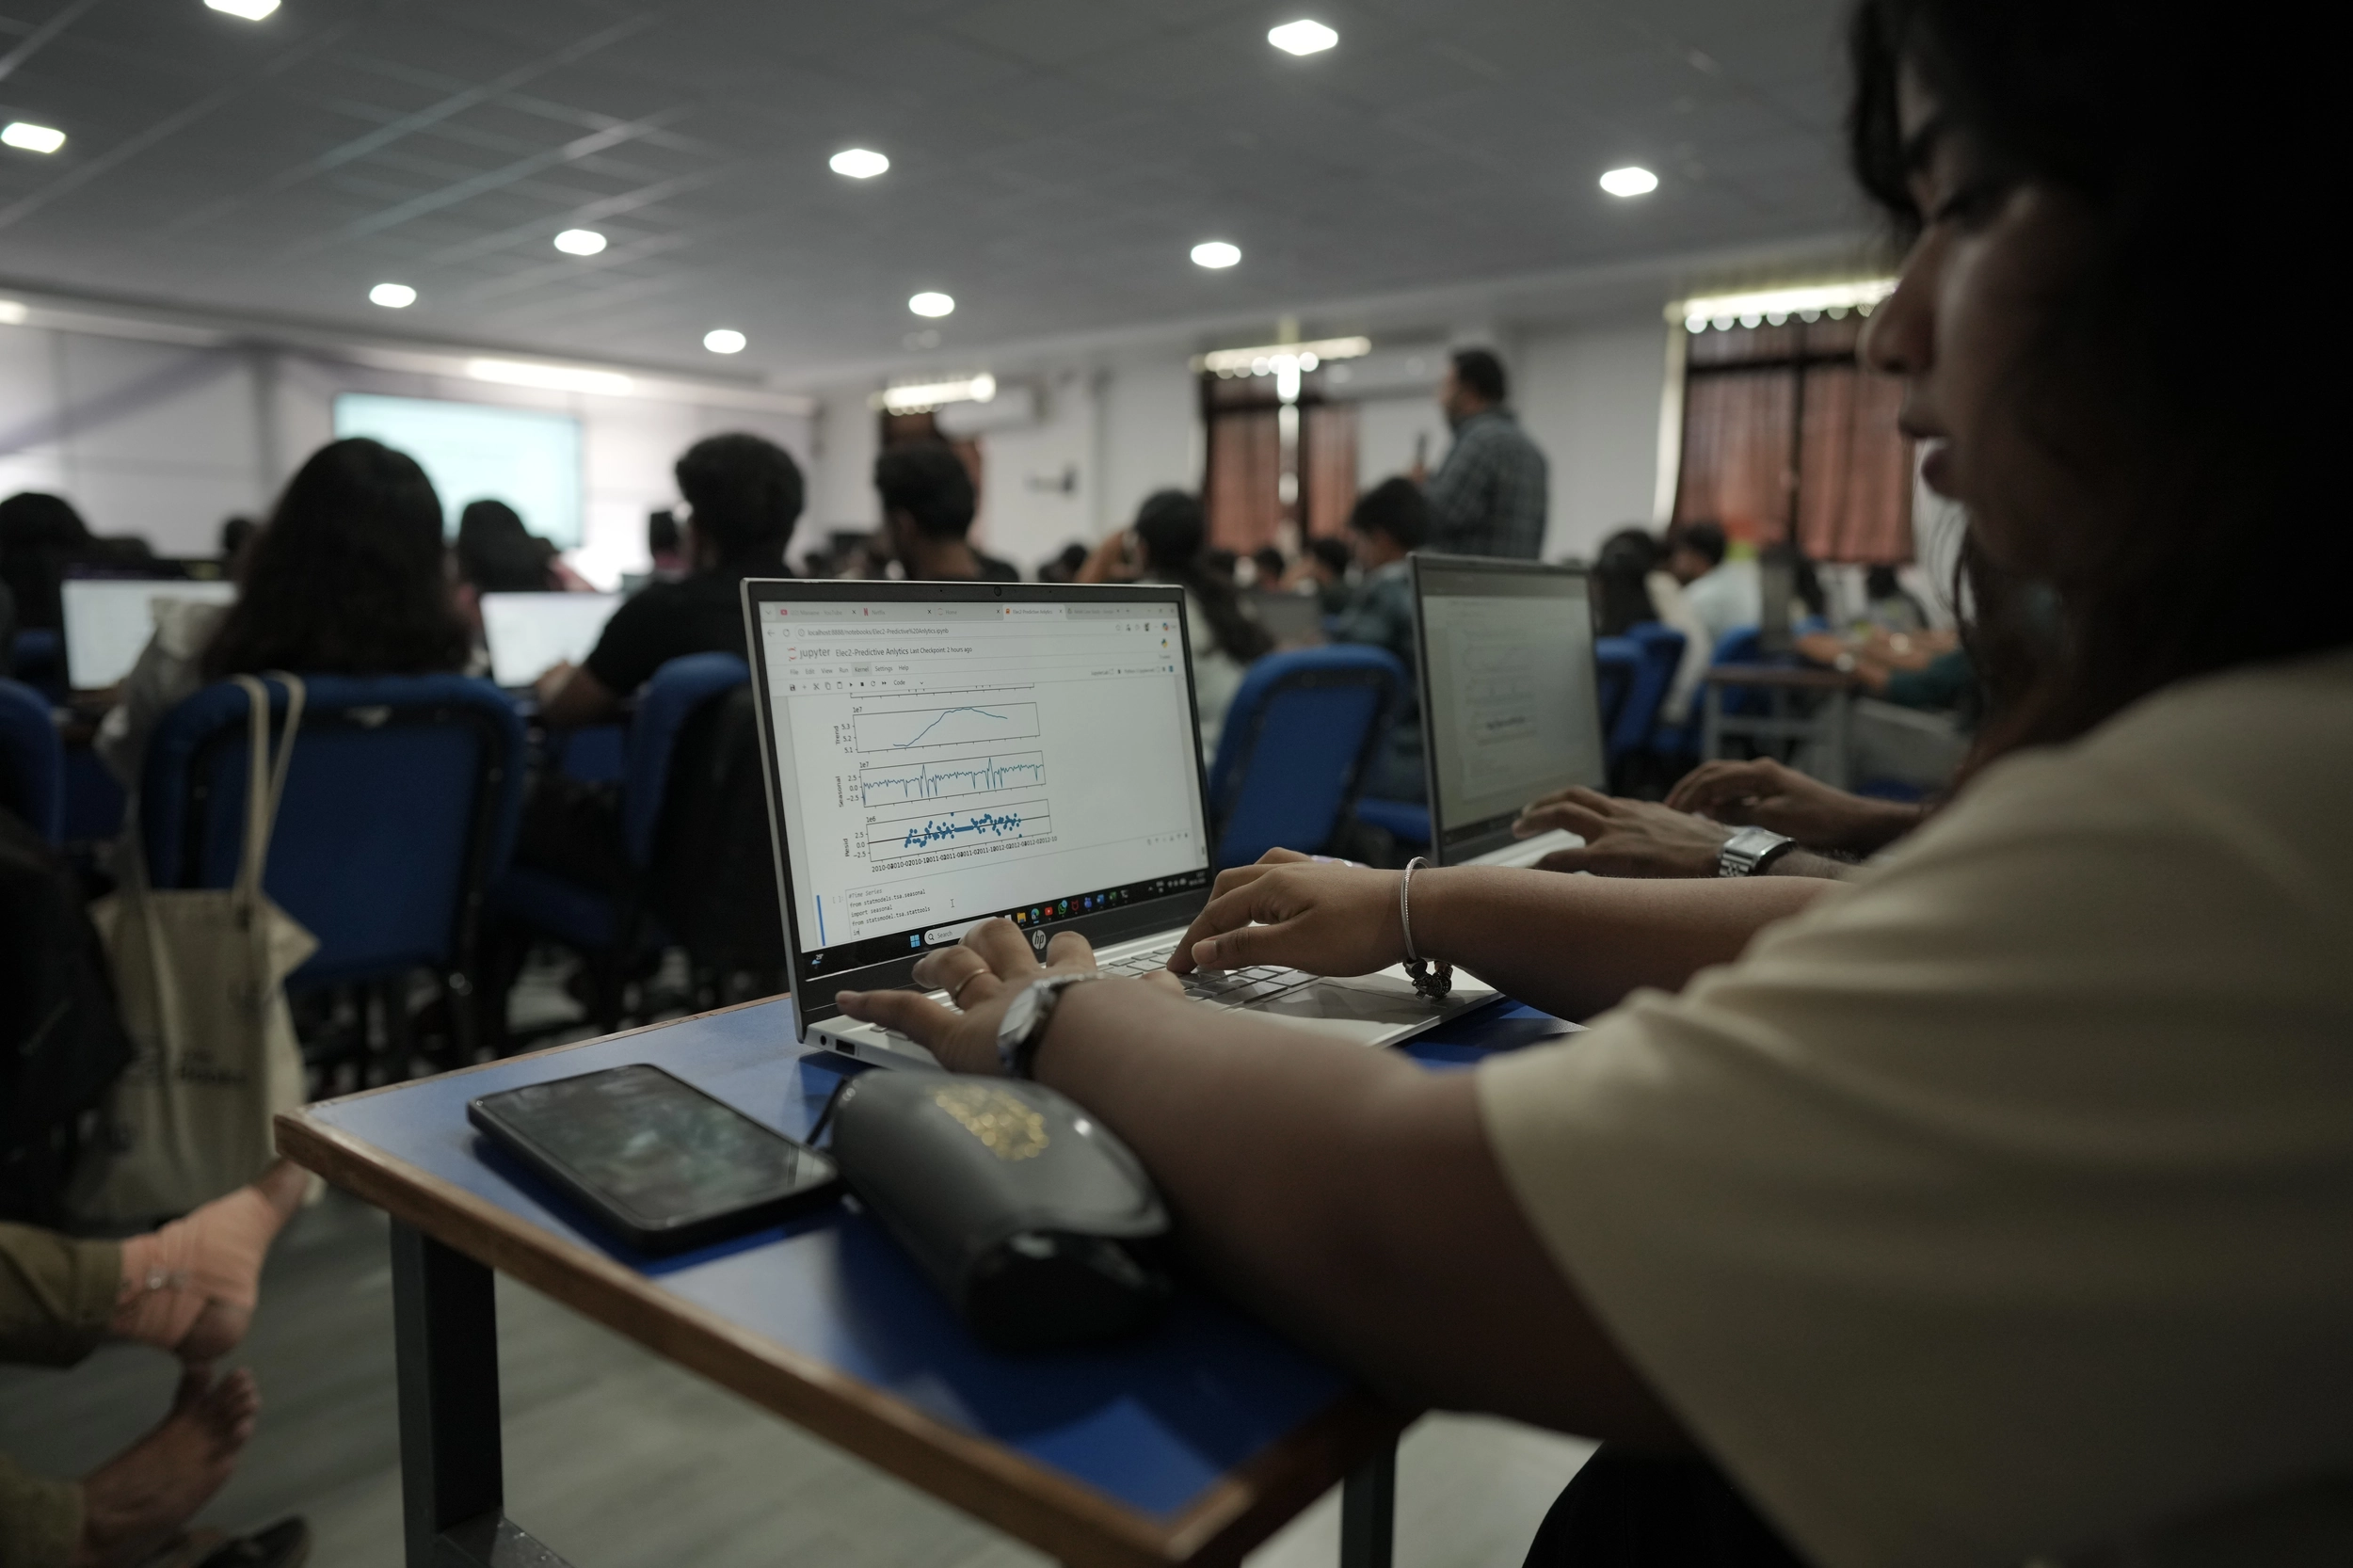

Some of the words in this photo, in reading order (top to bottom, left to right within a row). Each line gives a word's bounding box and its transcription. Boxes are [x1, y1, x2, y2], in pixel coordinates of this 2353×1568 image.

[799, 648, 830, 659] jupyter
[835, 649, 884, 657] Elec2-Predictive
[886, 648, 909, 656] Anlytics
[835, 776, 844, 808] Seasonal
[864, 889, 926, 906] statmodels.tsa.seasonal
[865, 888, 882, 896] Series
[866, 906, 930, 924] statsmodel.tsa.stattools
[871, 904, 893, 914] seasonal
[937, 930, 953, 939] Search
[1034, 930, 1045, 950] hp
